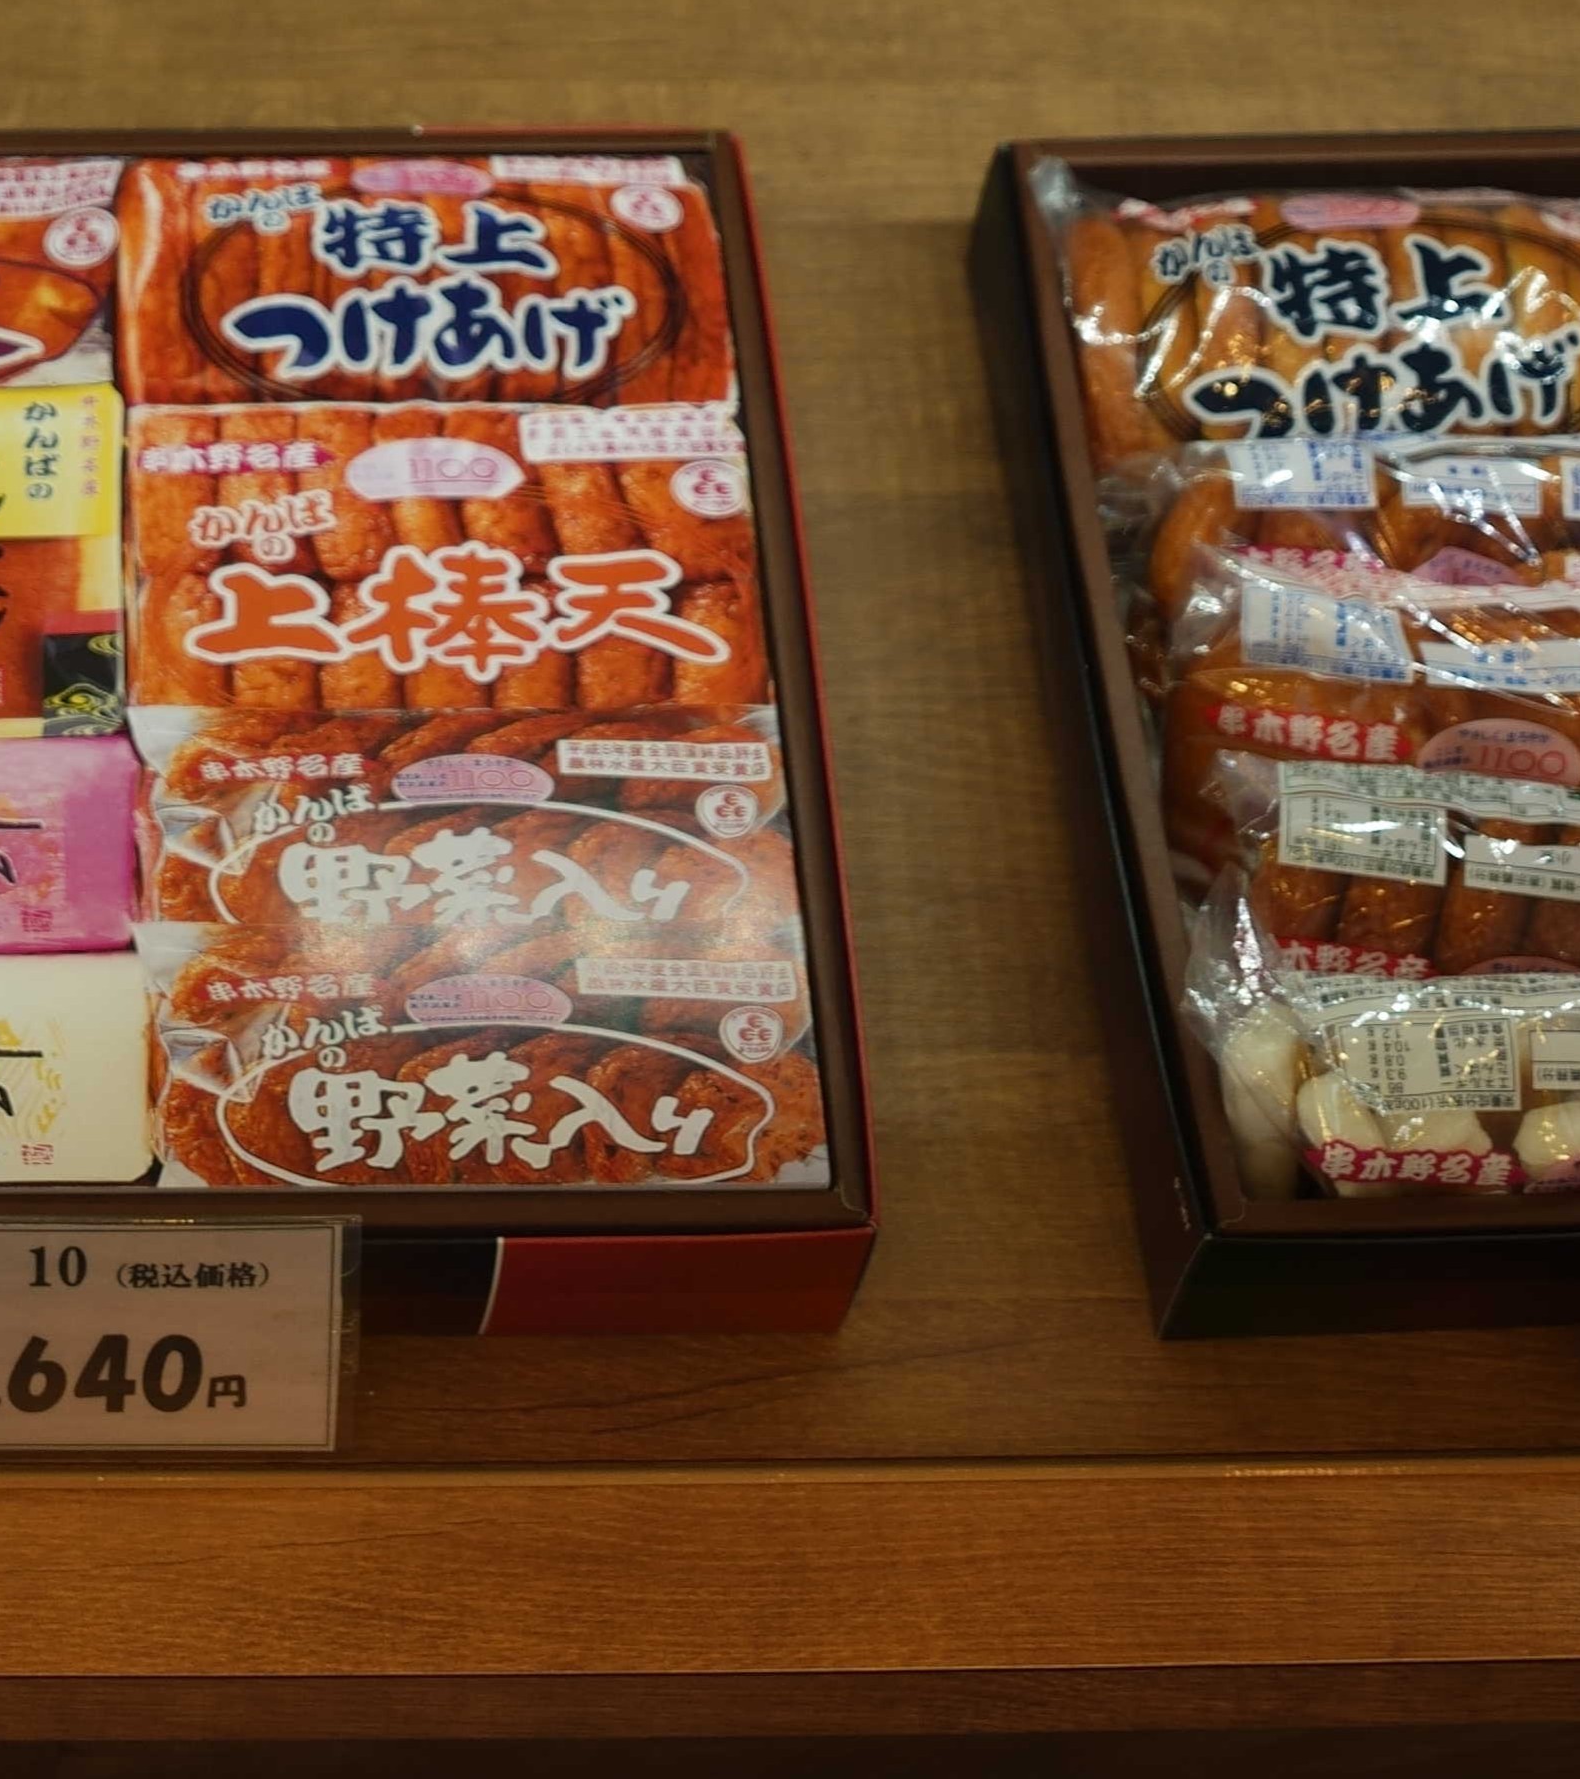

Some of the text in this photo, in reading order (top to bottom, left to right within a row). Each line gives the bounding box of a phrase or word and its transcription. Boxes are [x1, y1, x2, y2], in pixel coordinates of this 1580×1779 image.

[322, 203, 552, 271] 特上
[229, 279, 628, 371] つけあげ
[1268, 240, 1505, 335] 特上
[24, 401, 60, 502] かんばの
[188, 547, 727, 681] 上棒天
[252, 784, 373, 845] かんばの
[276, 827, 694, 923] 野菜入り
[259, 1006, 390, 1067] かんばの
[287, 1051, 716, 1174] 野菜入り
[28, 1245, 88, 1288] 10
[115, 1261, 271, 1289] (税込価格)
